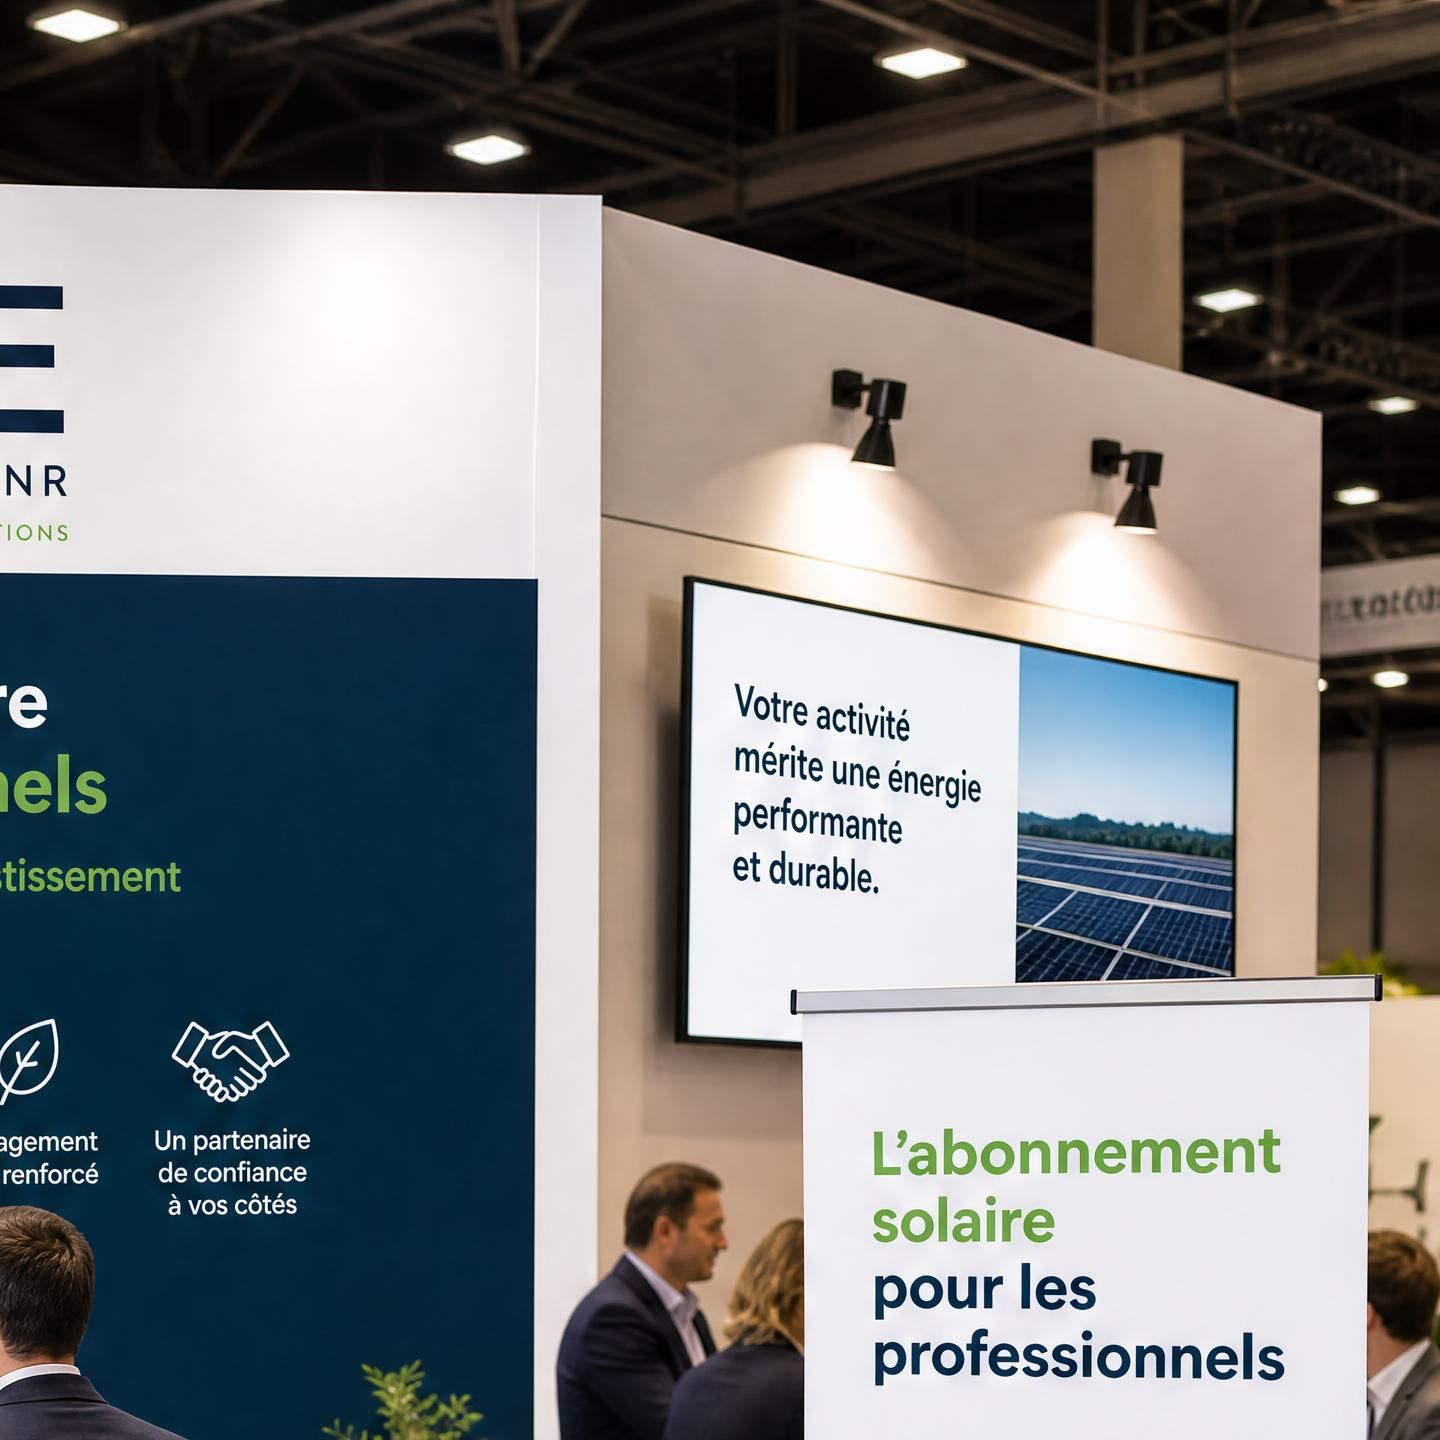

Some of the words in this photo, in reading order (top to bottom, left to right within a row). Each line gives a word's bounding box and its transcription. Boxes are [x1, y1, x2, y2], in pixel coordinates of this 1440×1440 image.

[735, 683, 807, 726] Votre
[817, 703, 909, 741] activité
[736, 742, 823, 782] mérite
[833, 761, 880, 789] une
[889, 760, 981, 808] énergie
[735, 797, 902, 844] performante
[733, 852, 760, 882] et
[769, 851, 878, 894] durable.
[155, 1130, 185, 1150] Un
[194, 1128, 310, 1155] partenaire
[874, 1129, 1281, 1176] L’abonnement
[3, 1163, 98, 1184] renforcé
[159, 1162, 187, 1183] de
[194, 1161, 307, 1183] confiance
[169, 1194, 181, 1215] à
[188, 1200, 227, 1215] vos
[235, 1193, 297, 1215] côtés
[873, 1196, 1054, 1243] solaire
[875, 1275, 1003, 1320] pour
[1021, 1263, 1096, 1310] les
[875, 1329, 1284, 1386] professionnels
